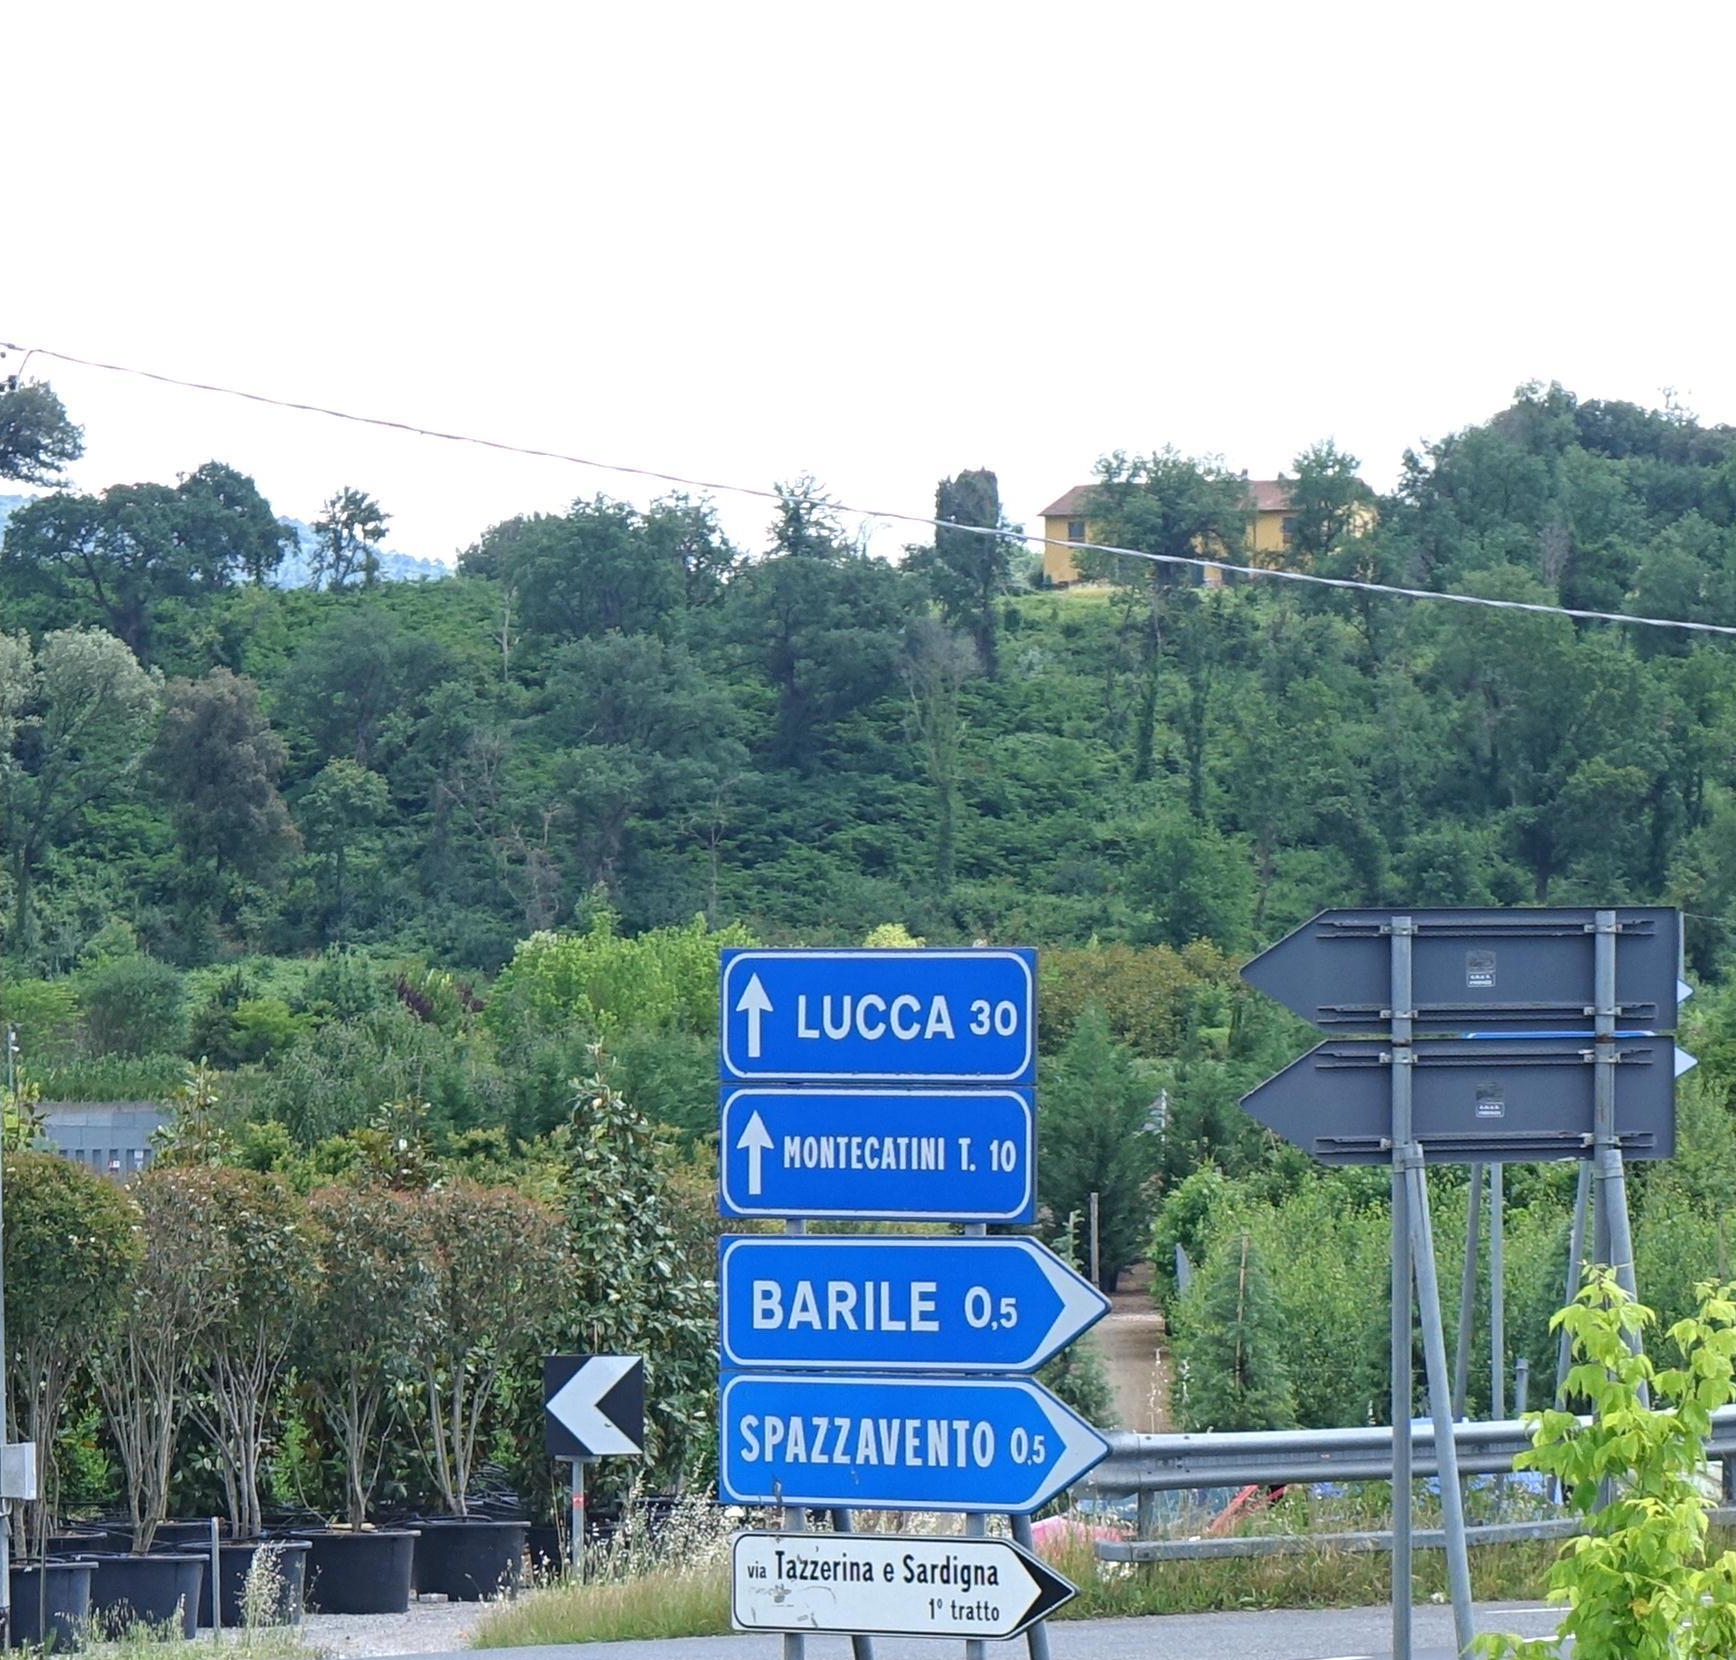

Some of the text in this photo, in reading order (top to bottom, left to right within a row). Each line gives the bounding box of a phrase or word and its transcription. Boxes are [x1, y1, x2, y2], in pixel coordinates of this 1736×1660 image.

[797, 994, 1018, 1040] LUCCA 30
[783, 1136, 1017, 1172] MONTECATINI T. 10
[752, 1280, 1018, 1331] BARILE 0,5
[739, 1414, 1046, 1468] SPAZZAVENTO 0,5
[746, 1551, 1000, 1592] via Tazzerina e Sardigna
[950, 1600, 1000, 1621] tratto
